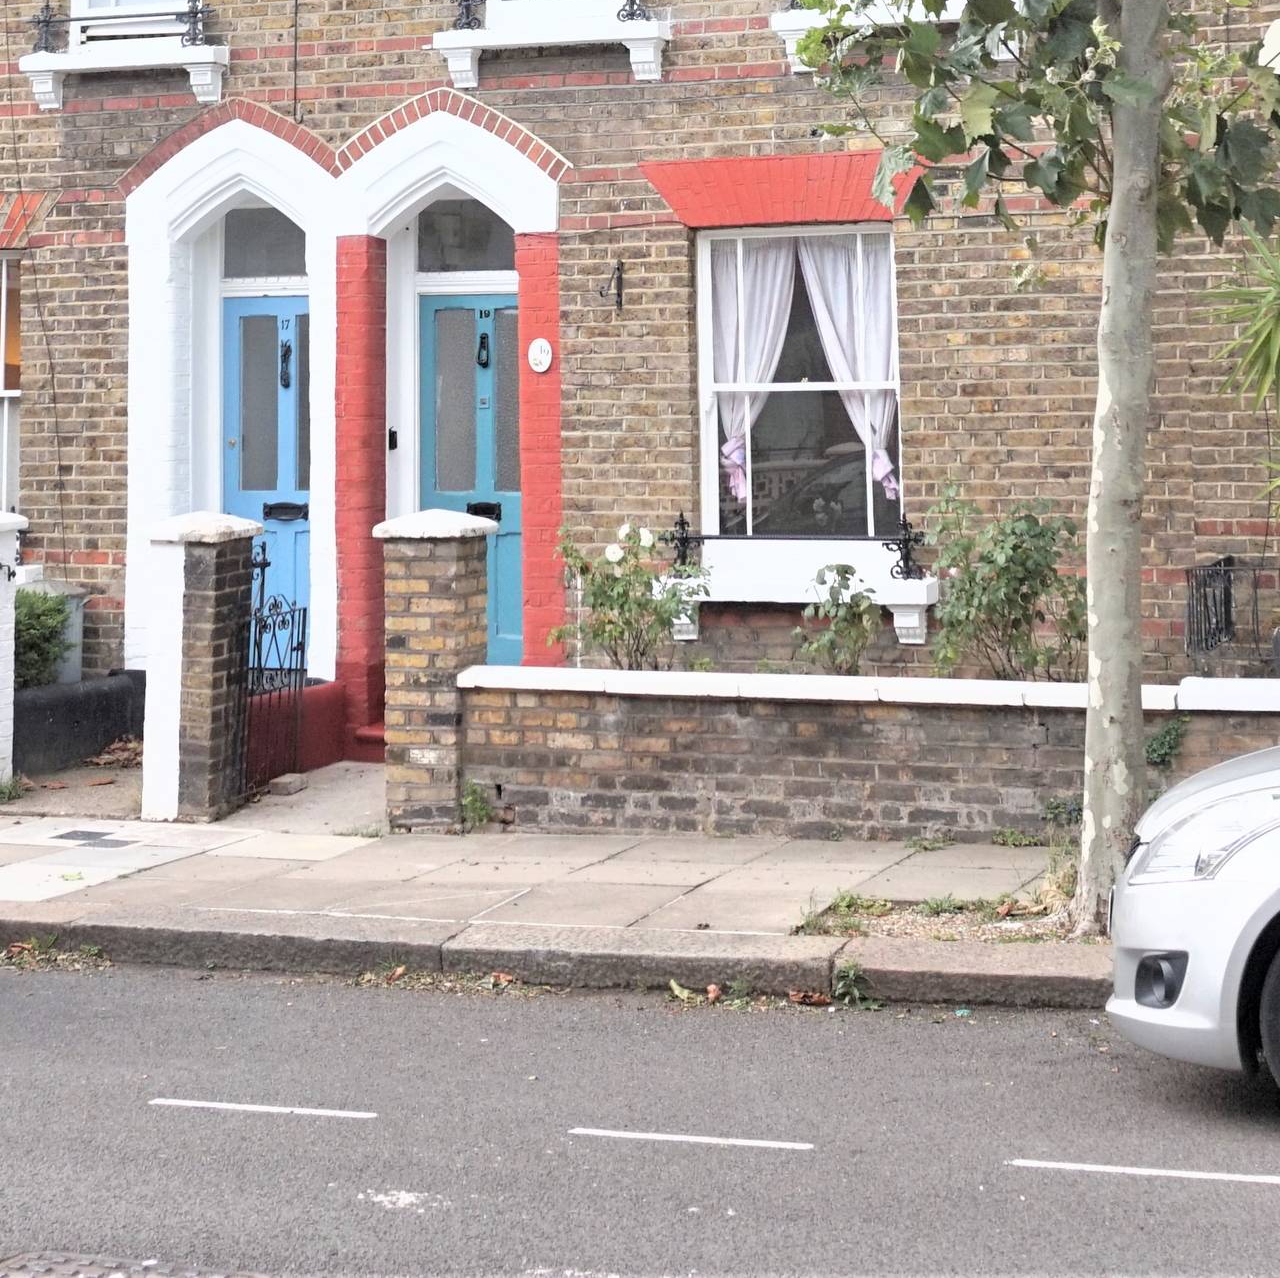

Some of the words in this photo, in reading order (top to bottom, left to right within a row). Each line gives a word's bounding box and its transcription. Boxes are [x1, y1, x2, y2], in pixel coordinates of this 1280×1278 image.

[480, 309, 491, 319] 19
[281, 319, 290, 330] 17
[540, 345, 550, 356] 19
